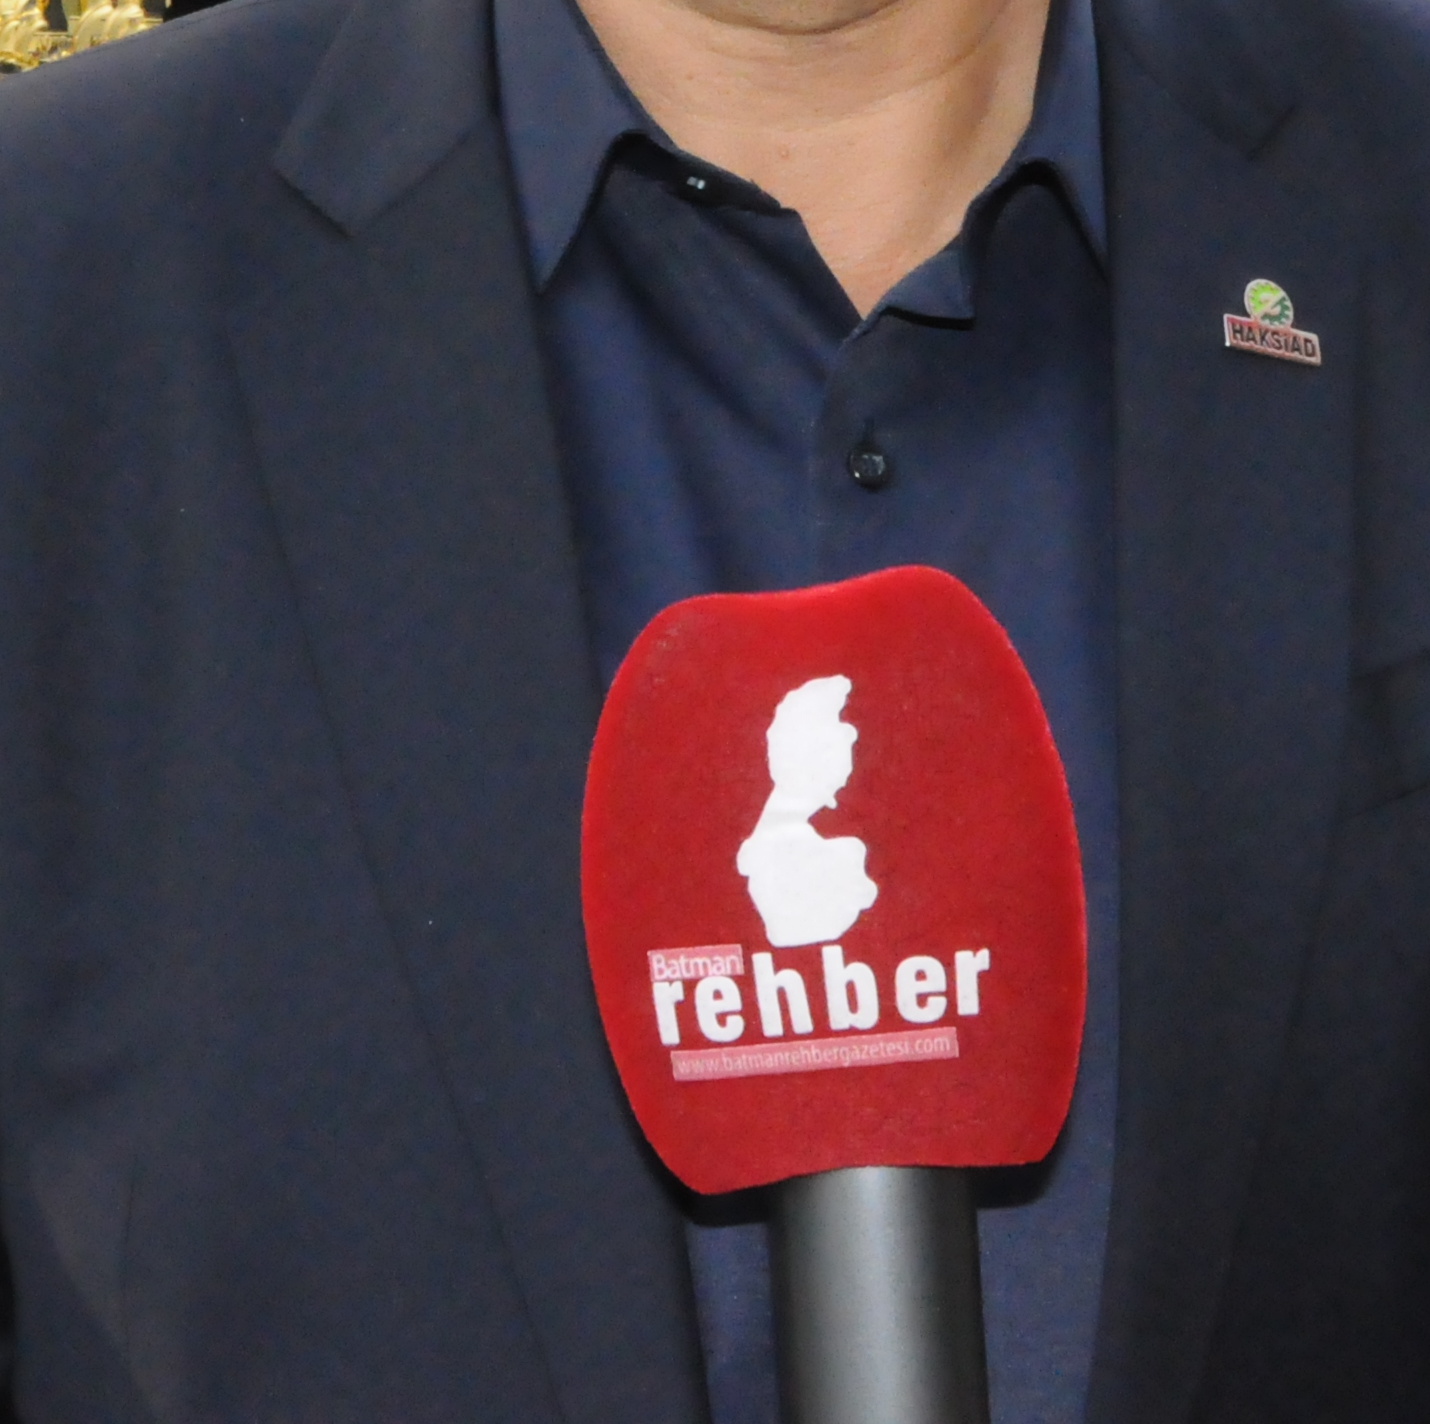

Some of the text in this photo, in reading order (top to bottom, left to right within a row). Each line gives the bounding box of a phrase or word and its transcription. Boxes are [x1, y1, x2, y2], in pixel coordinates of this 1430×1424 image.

[652, 952, 742, 978] Batman
[652, 944, 991, 1047] rehber
[676, 1036, 951, 1075] www.batmanrehbergazetesi.com
